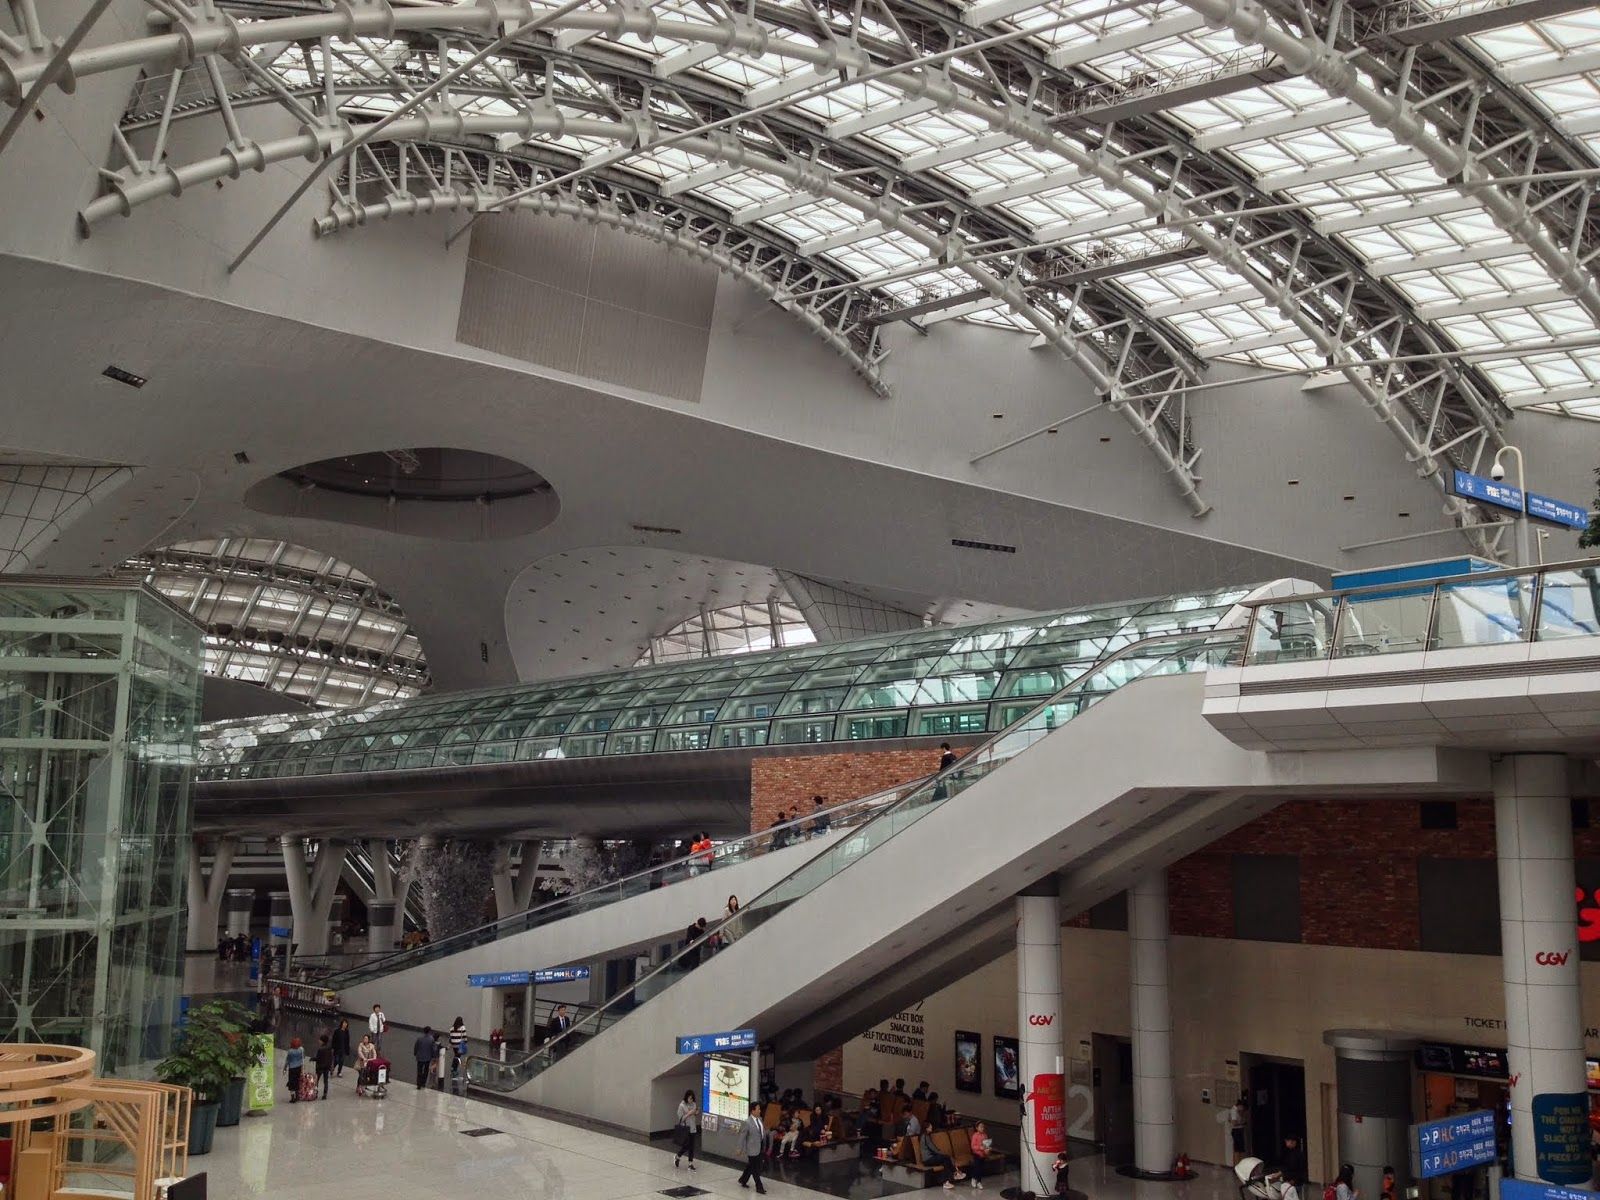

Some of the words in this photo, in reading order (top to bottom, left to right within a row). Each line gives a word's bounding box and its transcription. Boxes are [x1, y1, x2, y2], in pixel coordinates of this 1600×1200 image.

[1536, 951, 1568, 966] CGV
[891, 1012, 909, 1021] ICKET
[911, 1013, 924, 1023] BOX
[1029, 1014, 1053, 1026] CGV
[1464, 1017, 1501, 1029] TICKET
[890, 1022, 910, 1033] SNACK
[911, 1025, 924, 1035] BAR
[1584, 1028, 1598, 1038] AR
[876, 1032, 906, 1045] TICKETING
[907, 1036, 924, 1047] ZONE
[873, 1043, 912, 1057] AUDITORIUM
[913, 1050, 924, 1059] 1/2
[1432, 1130, 1439, 1143] P
[1434, 1156, 1440, 1169] P
